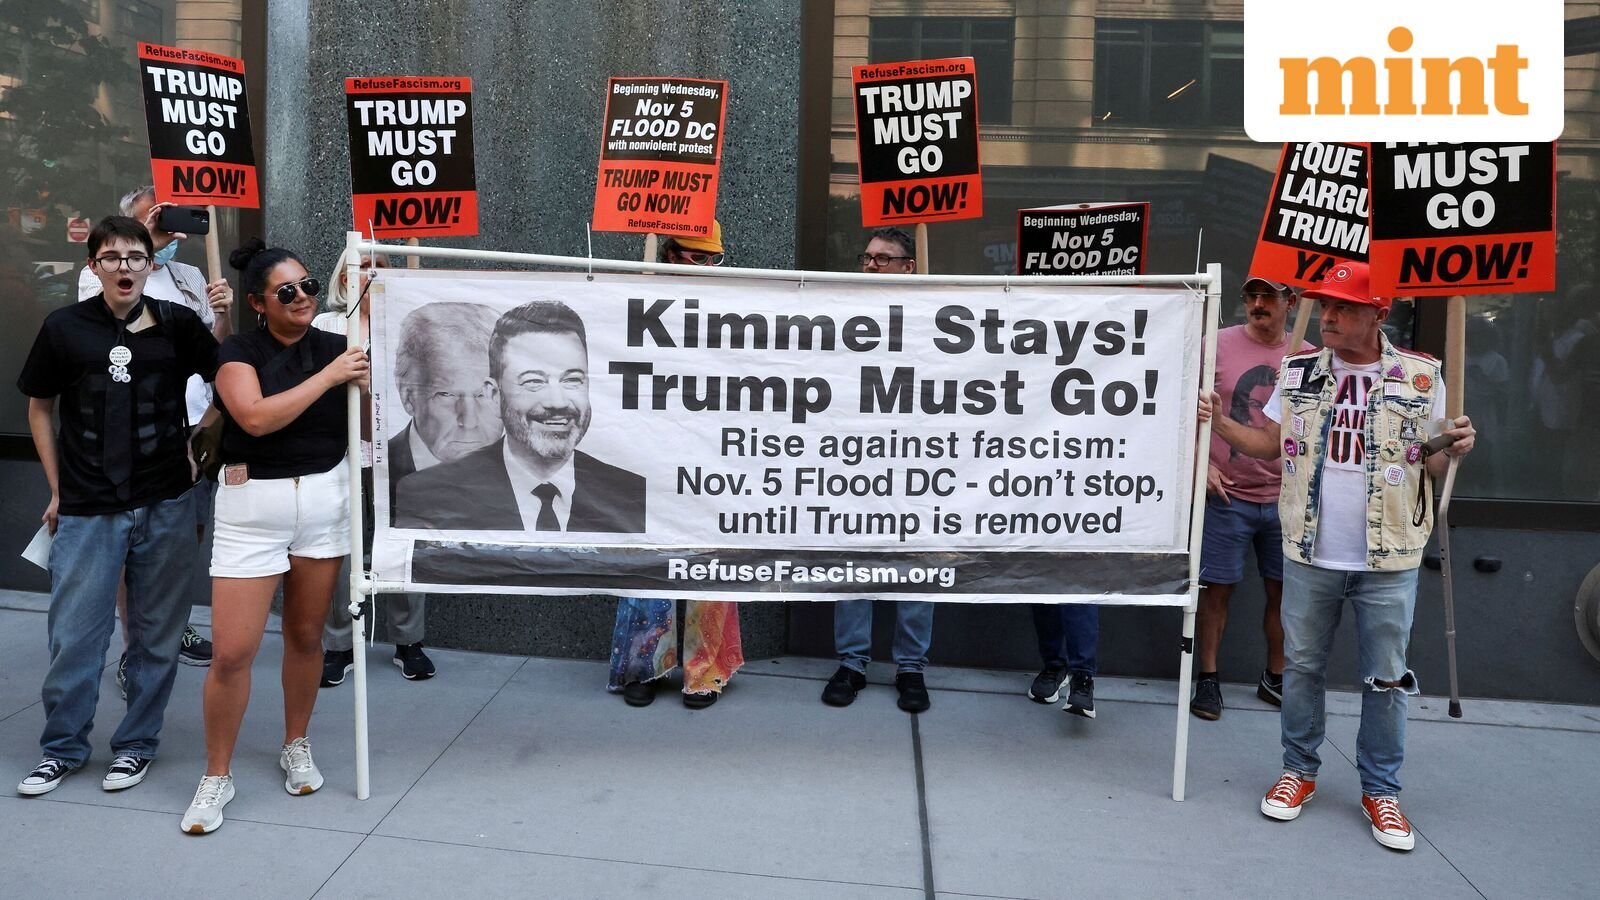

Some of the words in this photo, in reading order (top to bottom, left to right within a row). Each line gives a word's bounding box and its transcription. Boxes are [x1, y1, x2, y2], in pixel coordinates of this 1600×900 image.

[145, 45, 237, 70] RefuseFascism.org
[860, 61, 966, 79] RefuseFascism.org
[147, 66, 243, 101] TRUMP
[354, 78, 461, 91] RefuseFascism.org
[613, 83, 659, 97] Beginning
[661, 84, 719, 100] Wednesday,
[859, 79, 972, 114] TRUMP
[161, 98, 238, 129] MUST
[354, 100, 467, 126] TRUMP
[635, 99, 675, 117] Nov
[679, 101, 694, 117] 5
[185, 129, 226, 156] GO
[367, 129, 457, 156] MUST
[610, 119, 680, 138] FLOOD
[684, 121, 717, 141] DC
[873, 112, 963, 145] MUST
[608, 140, 627, 151] with
[628, 141, 677, 154] nonviolent
[678, 143, 713, 155] protest
[897, 145, 944, 175] GO
[172, 166, 246, 195] NOW!
[391, 160, 437, 186] GO
[603, 168, 659, 189] TRUMP
[661, 171, 712, 193] MUST
[1394, 145, 1530, 190] MUST
[616, 193, 642, 212] GO
[644, 194, 691, 215] NOW!
[882, 182, 969, 215] NOW!
[1280, 173, 1369, 218] LARGU
[1426, 190, 1496, 230] GO
[373, 197, 462, 226] NOW!
[1024, 216, 1077, 228] Beginning
[1080, 211, 1140, 226] Wednesday,
[628, 218, 708, 235] RefuseFascism.org
[1051, 232, 1095, 249] Nov
[1100, 228, 1114, 246] 5
[1025, 250, 1102, 270] FLOOD
[1107, 246, 1139, 266] DC
[1398, 241, 1533, 283] NOW!
[626, 298, 902, 353] Kimmel
[933, 305, 1148, 365] Stays!
[608, 361, 832, 424] Trump
[859, 366, 1025, 416] Must
[1050, 368, 1158, 417] Go!
[721, 428, 805, 458] Rise
[820, 429, 960, 465] against
[972, 429, 1127, 460] fascism:
[676, 466, 753, 496] Nov.
[762, 467, 782, 497] 5
[794, 467, 894, 497] Flood
[905, 468, 957, 497] DC
[1083, 471, 1164, 504] stop,
[717, 505, 797, 535] until
[806, 506, 921, 541] Trump
[932, 507, 962, 535] is
[974, 507, 1122, 536] removed
[668, 559, 957, 588] RefuseFascism.org
